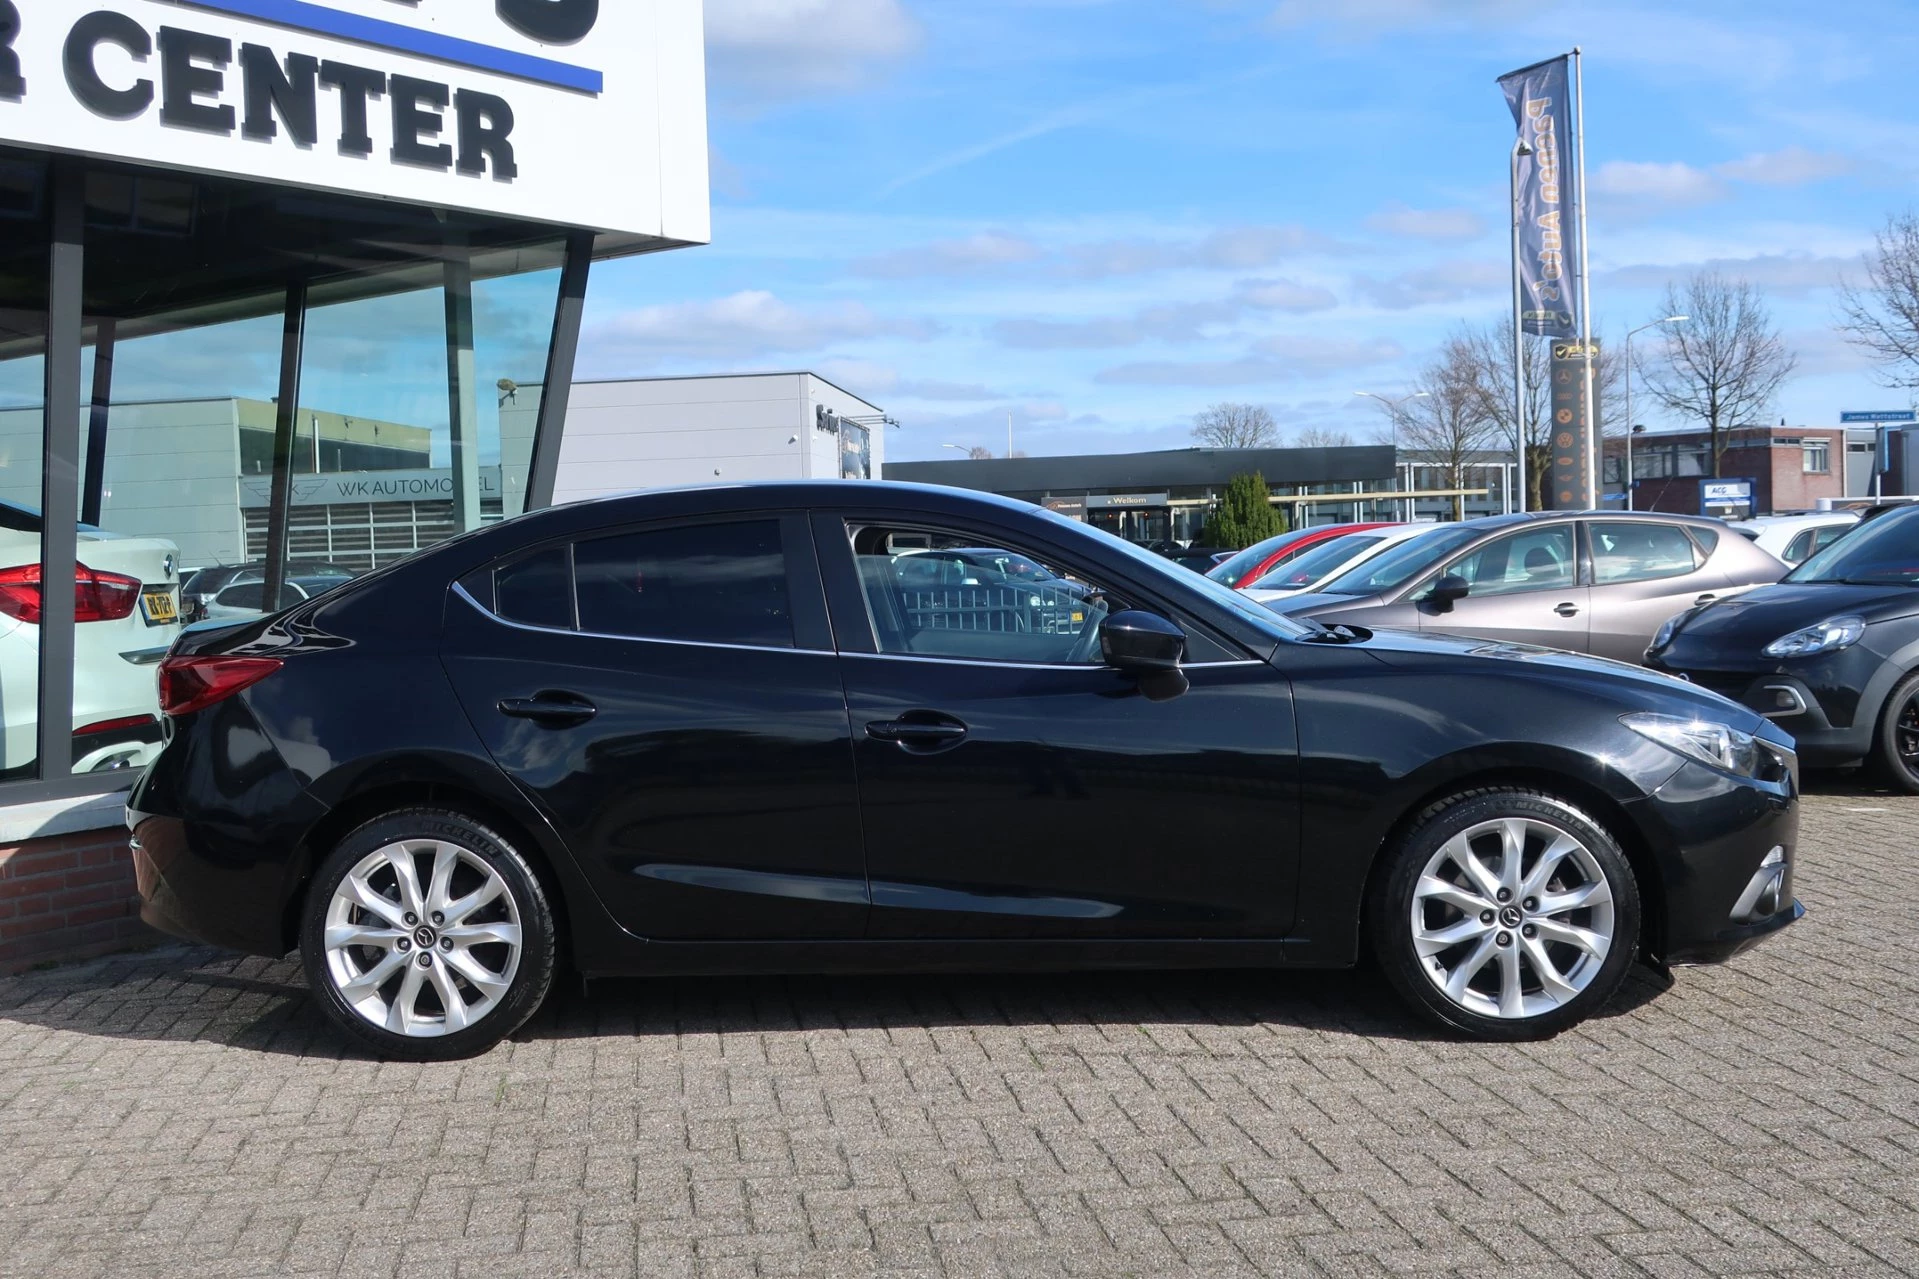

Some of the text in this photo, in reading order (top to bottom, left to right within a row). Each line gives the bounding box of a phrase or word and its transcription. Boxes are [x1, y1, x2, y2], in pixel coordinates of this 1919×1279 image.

[63, 10, 518, 181] CENTER
[337, 480, 369, 497] WK
[1515, 801, 1584, 831] MICHELIN
[421, 820, 498, 855] MICHELIN
